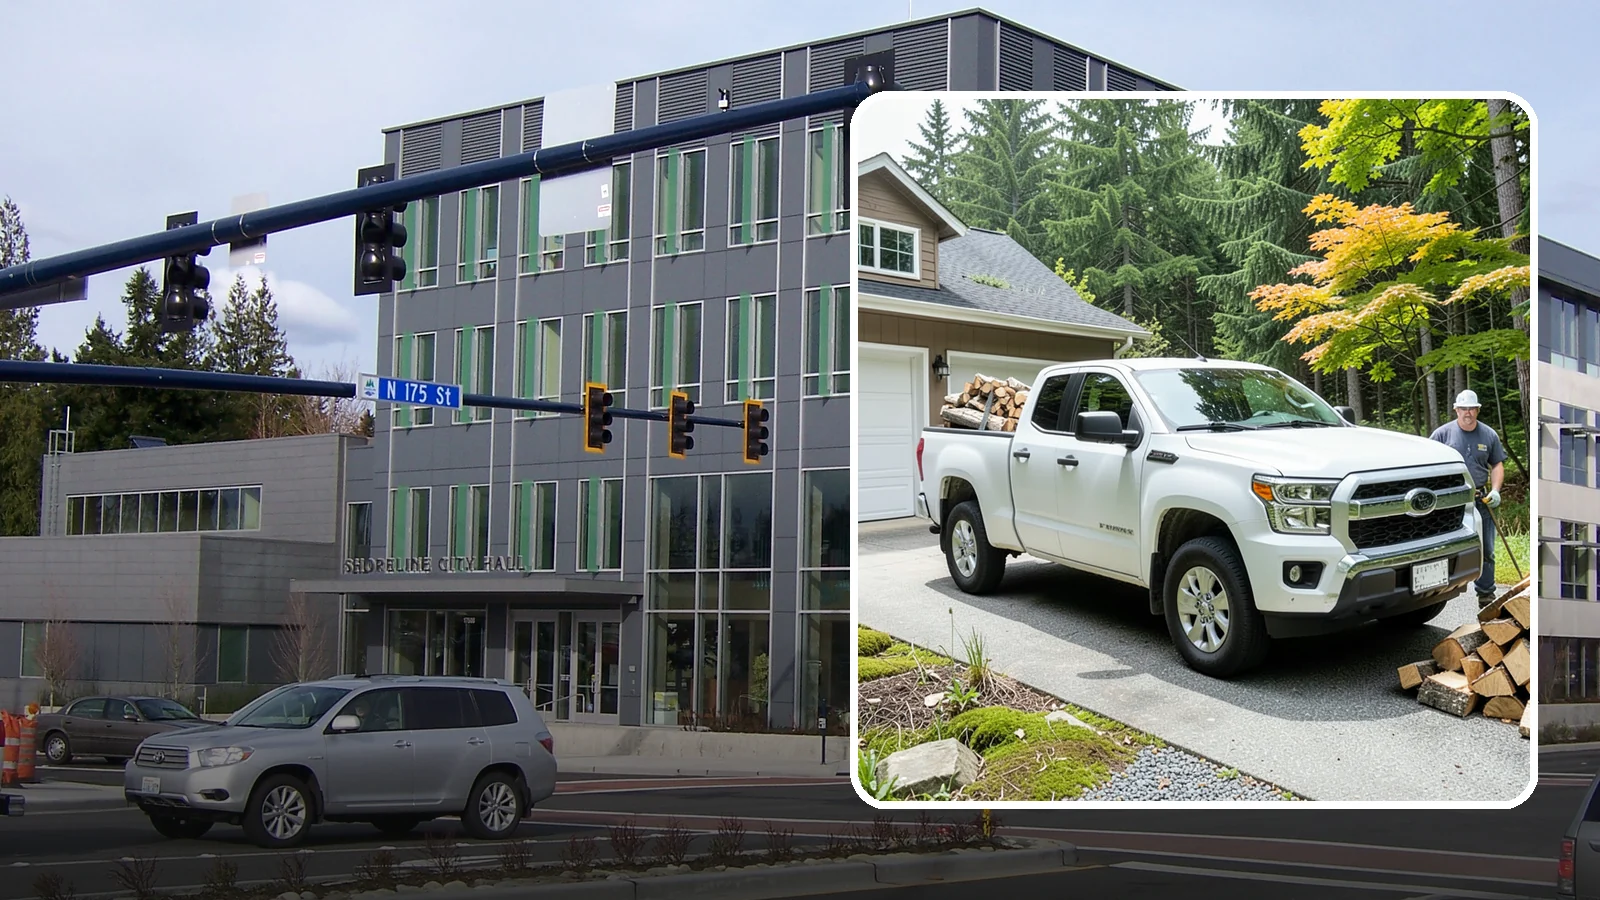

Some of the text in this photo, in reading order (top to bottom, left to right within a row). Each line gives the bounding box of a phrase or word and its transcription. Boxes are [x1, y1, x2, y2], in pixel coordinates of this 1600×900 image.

[387, 380, 451, 406] N 175 St
[344, 556, 525, 573] SHORELINE CITY HALL
